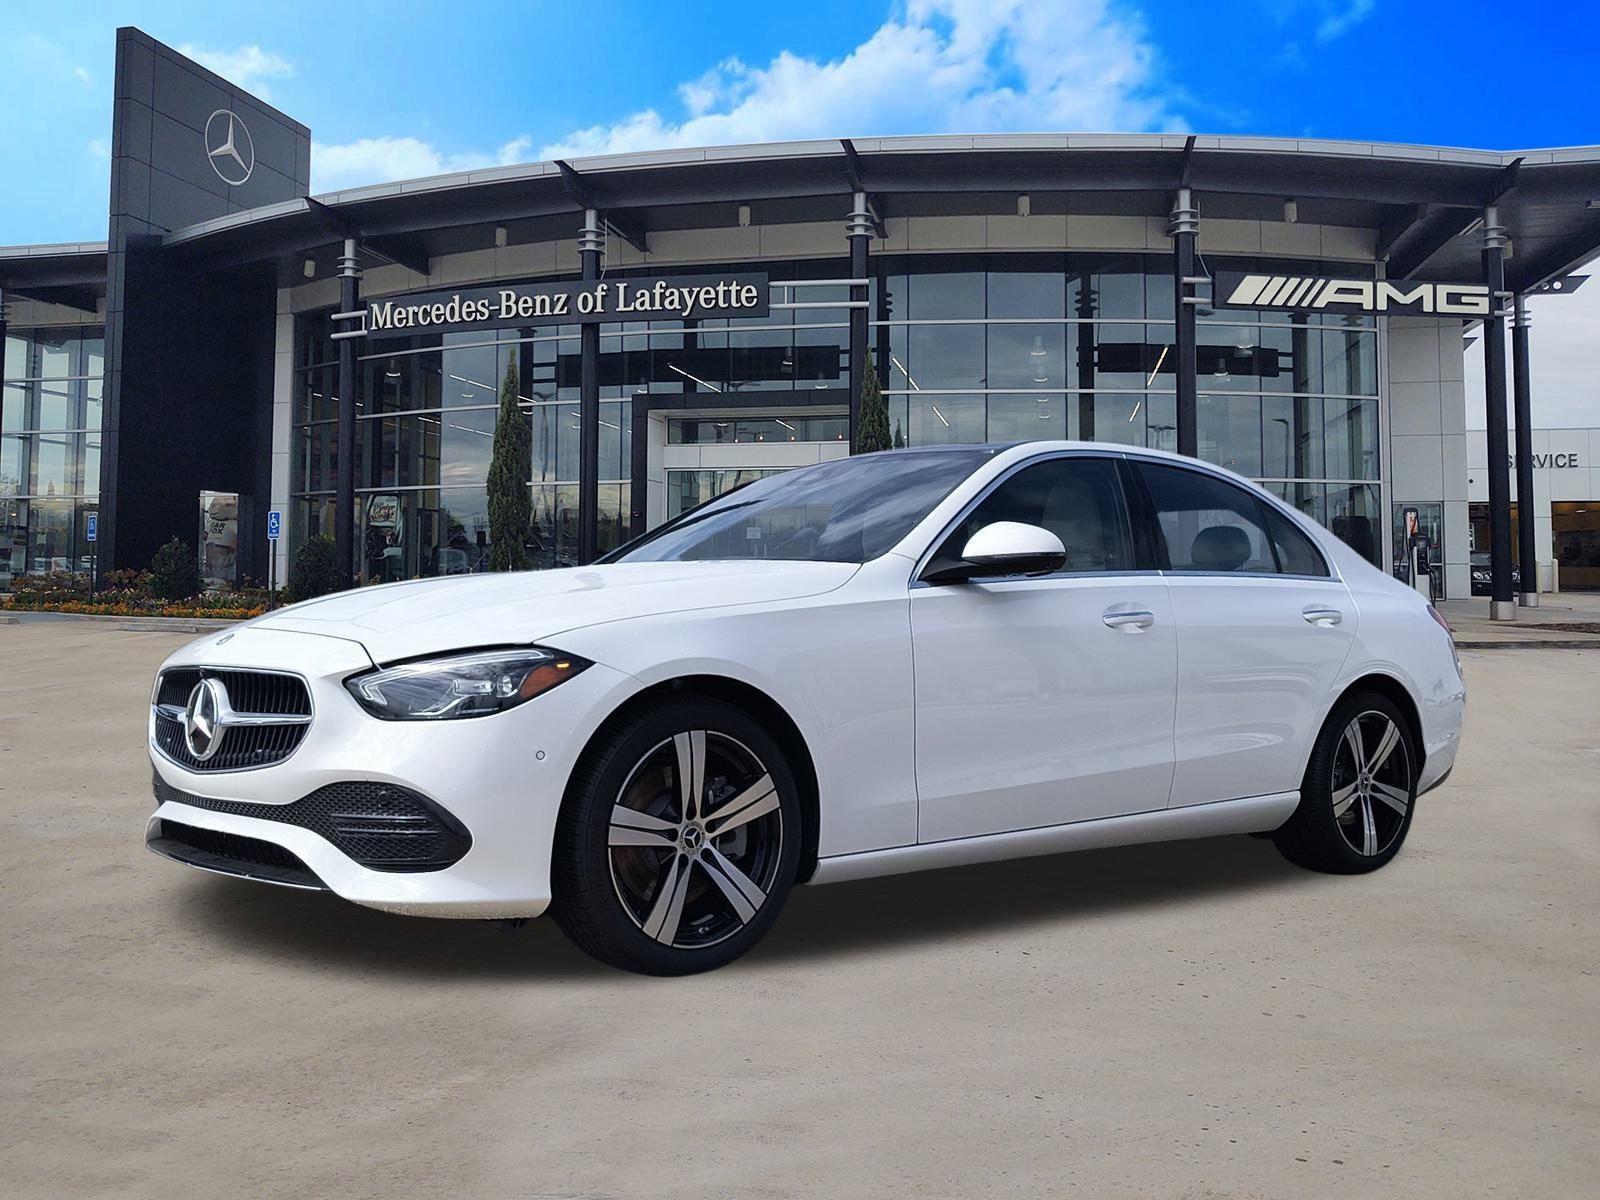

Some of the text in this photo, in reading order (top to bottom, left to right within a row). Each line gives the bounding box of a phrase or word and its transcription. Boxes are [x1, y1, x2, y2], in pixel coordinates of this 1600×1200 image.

[369, 280, 758, 330] Mercedes-Benz of Lafayette
[1312, 279, 1490, 315] AMG
